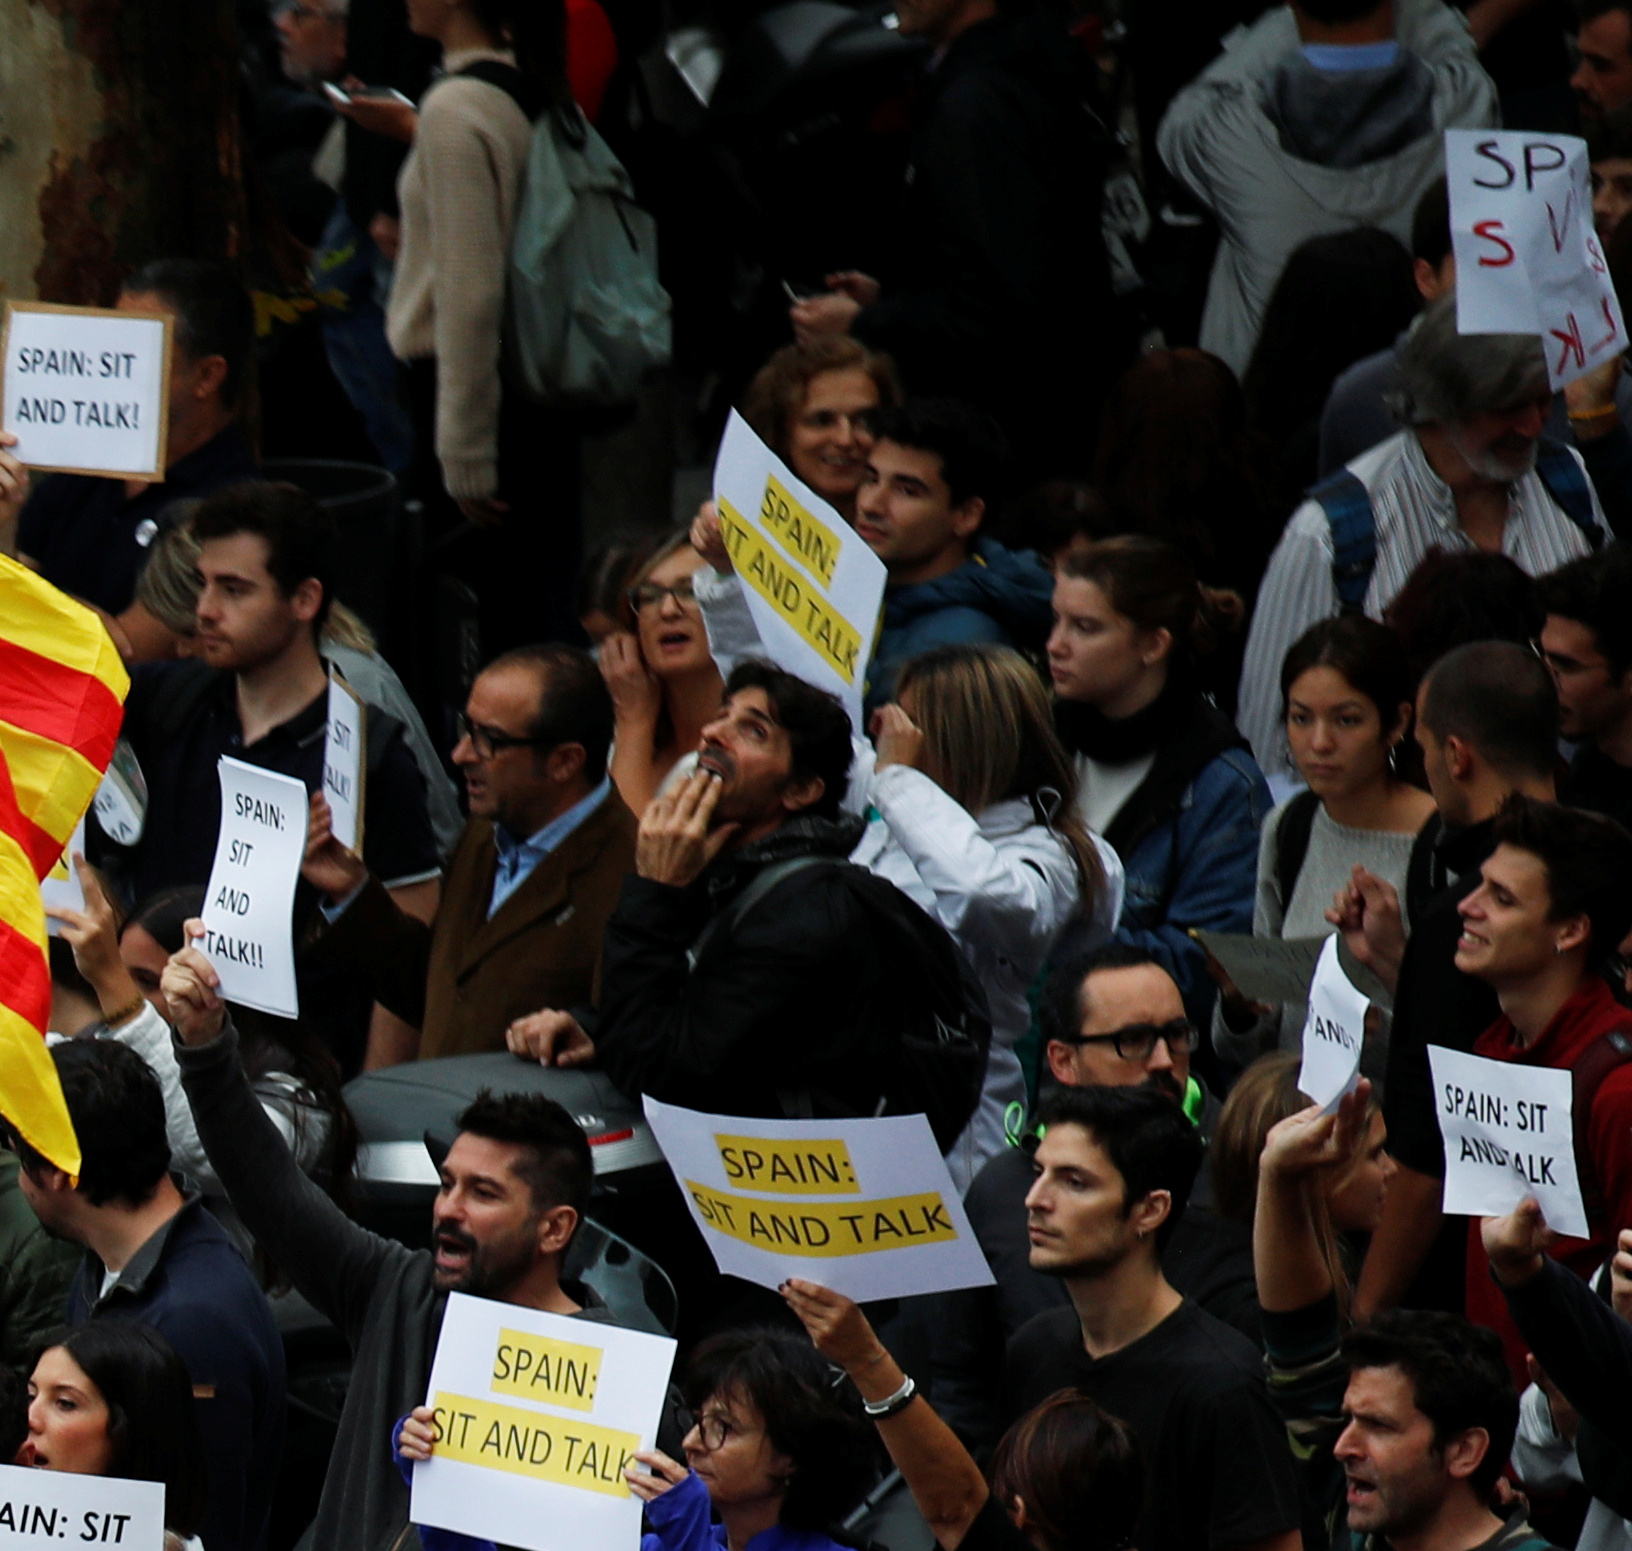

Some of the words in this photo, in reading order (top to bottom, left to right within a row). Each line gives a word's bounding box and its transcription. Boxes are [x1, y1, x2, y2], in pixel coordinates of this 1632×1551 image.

[18, 347, 92, 378] SPAIN:
[99, 352, 136, 380] SIT
[16, 398, 66, 425] AND
[72, 400, 140, 430] TALK!
[760, 485, 837, 581] SPAIN:
[749, 548, 801, 613] AND
[804, 599, 860, 678] TALK
[235, 793, 285, 832] SPAIN:
[229, 839, 254, 867] SIT
[215, 885, 250, 916] AND
[205, 929, 263, 969] TALK!!
[1445, 1083, 1508, 1127] SPAIN:
[1517, 1100, 1548, 1133] SIT
[721, 1146, 856, 1184] SPAIN:
[1508, 1150, 1557, 1187] ALK
[692, 1190, 735, 1229] SIT
[749, 1211, 829, 1248] AND
[840, 1202, 954, 1243] TALK
[493, 1345, 597, 1400] SPAIN:
[431, 1406, 477, 1450] SIT
[481, 1420, 553, 1466] AND
[78, 1511, 132, 1546] SIT
